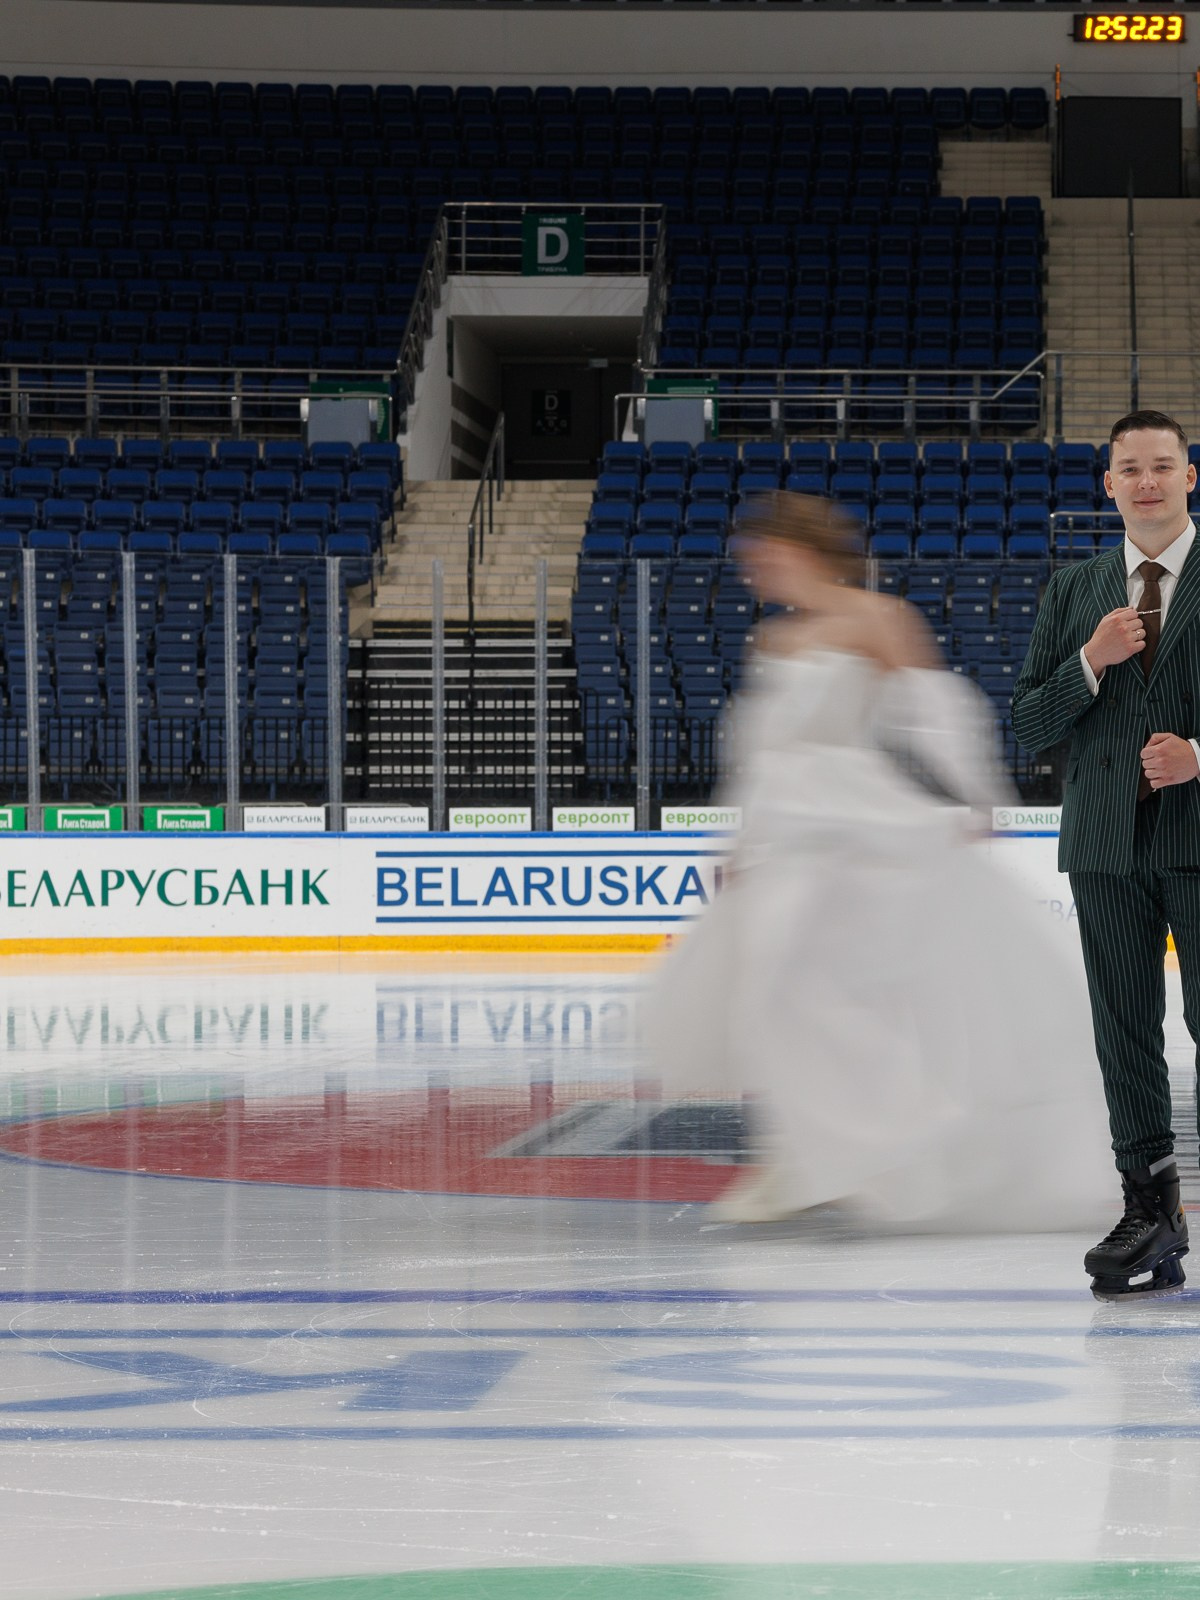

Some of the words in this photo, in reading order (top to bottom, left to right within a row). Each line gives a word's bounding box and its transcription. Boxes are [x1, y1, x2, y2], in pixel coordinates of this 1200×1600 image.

[1084, 15, 1183, 41] 12:52.23
[537, 226, 570, 264] D
[256, 814, 323, 824] БЕЛАРУСБАНК
[359, 814, 426, 824] БЕЛАРУСБАНК
[453, 812, 528, 828] евроопт
[556, 812, 630, 828] евроопт
[0, 869, 330, 907] ЕЛАРУСБАНК
